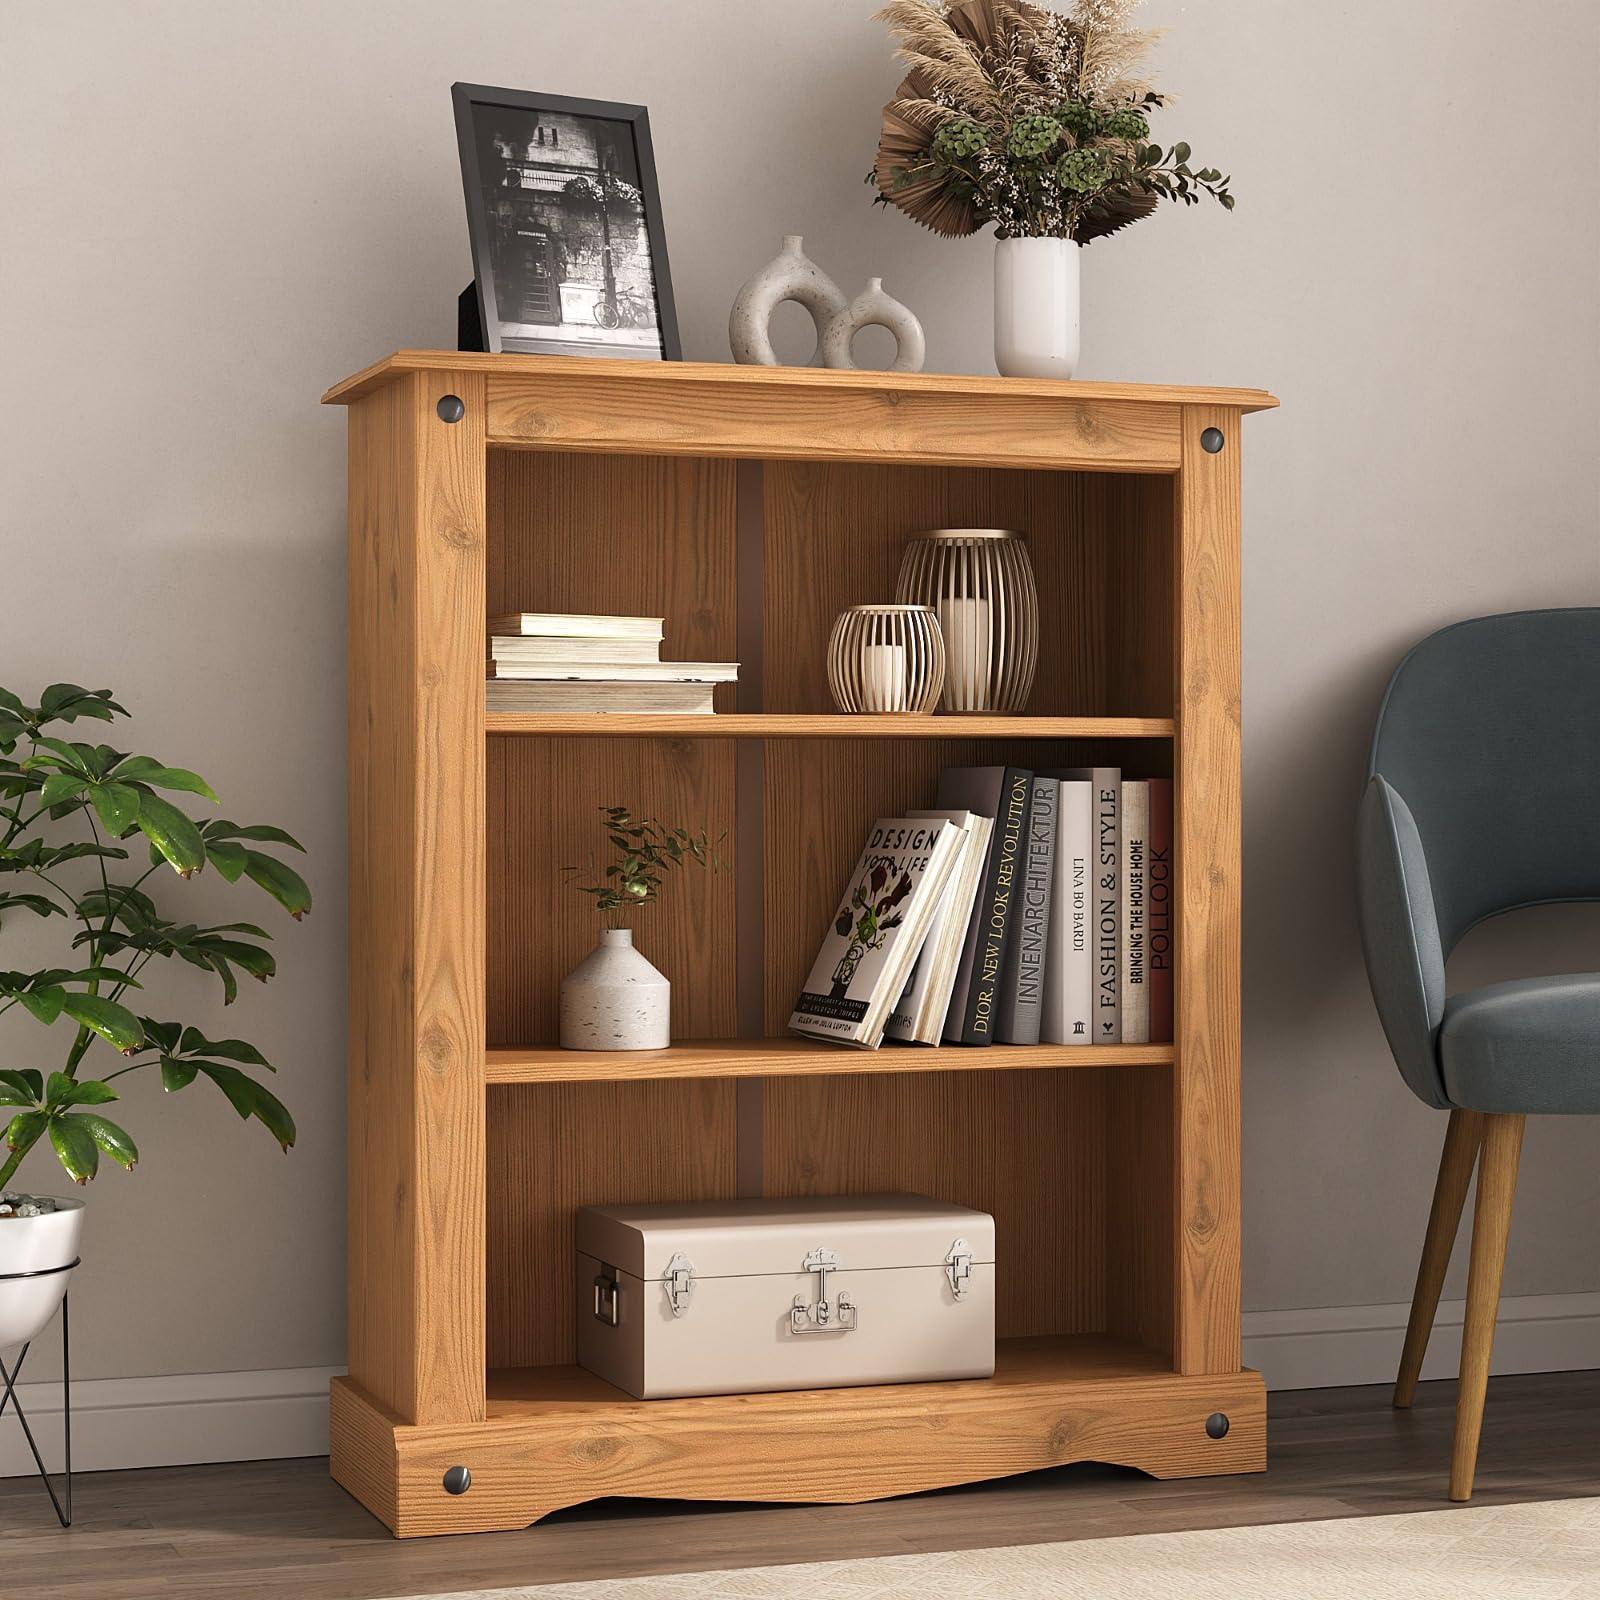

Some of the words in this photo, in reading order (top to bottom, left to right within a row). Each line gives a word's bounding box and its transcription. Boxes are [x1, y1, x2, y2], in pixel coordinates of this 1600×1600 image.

[870, 828, 940, 851] DESIGN
[997, 775, 1028, 887] REVOLUTION
[1100, 789, 1116, 865] STYLE
[898, 856, 929, 871] LIFE
[1073, 858, 1084, 888] LINA
[1130, 840, 1143, 869] HOME
[1018, 787, 1054, 1005] INNENARCHITEKTUR
[1073, 892, 1084, 909] BO
[1100, 872, 1116, 890] &
[1130, 872, 1143, 907] HOUSE
[989, 890, 1010, 939] LOOK
[1130, 909, 1143, 930] THE
[1150, 847, 1169, 969] POLLOCK
[1073, 912, 1084, 951] BARDI
[982, 942, 1000, 982] NEW
[1100, 899, 1116, 1008] FASHION
[1130, 933, 1143, 984] BRINGING
[973, 987, 994, 1034] DIOR.
